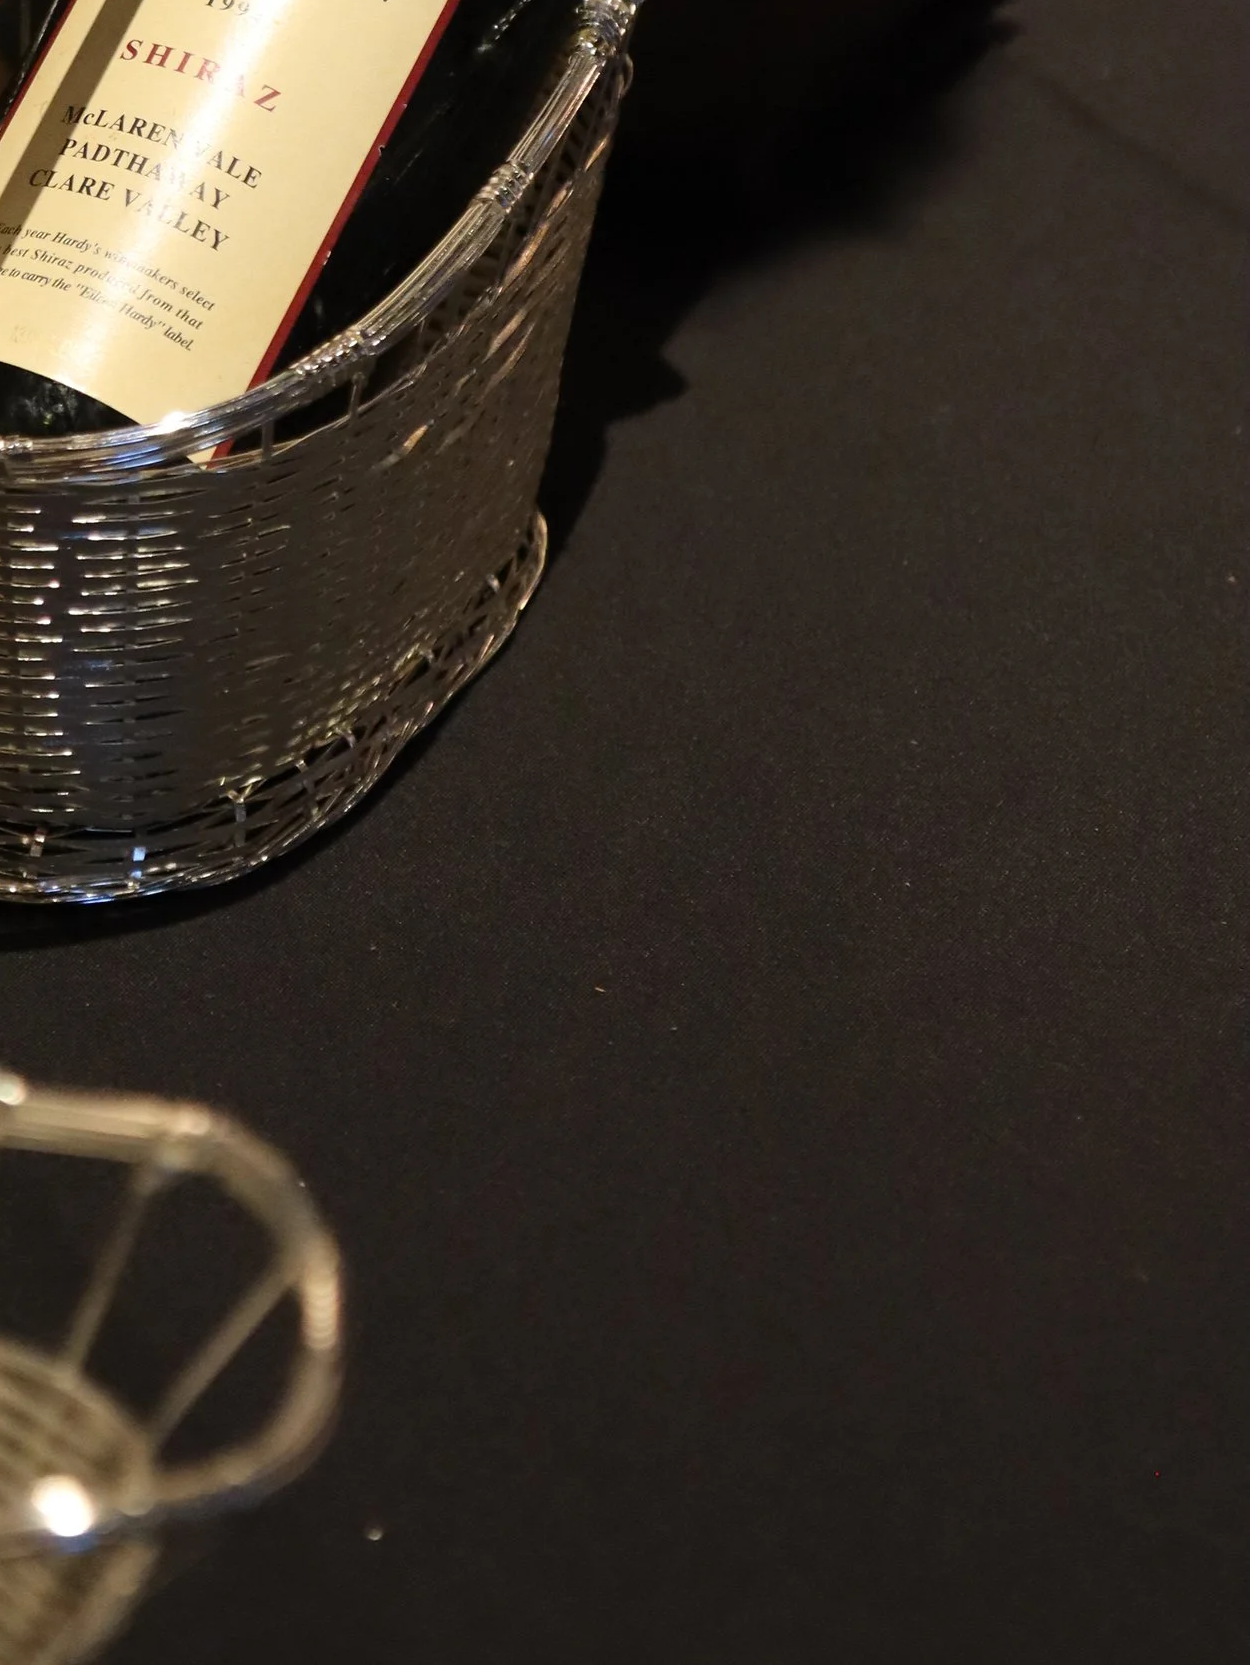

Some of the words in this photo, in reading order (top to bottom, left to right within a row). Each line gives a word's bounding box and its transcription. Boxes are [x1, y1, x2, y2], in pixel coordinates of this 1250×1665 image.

[60, 105, 186, 150] McLAREN
[194, 139, 263, 189] VALE
[29, 168, 115, 201] CLARE
[124, 188, 230, 252] VALLEY
[2, 244, 30, 258] best
[30, 248, 74, 270] Shiraz
[136, 288, 174, 312] from
[175, 308, 204, 330] that
[8, 268, 21, 278] to
[21, 272, 51, 288] carry
[51, 277, 72, 292] the
[21, 228, 52, 239] year
[51, 231, 102, 255] Hardy's
[179, 286, 216, 312] select
